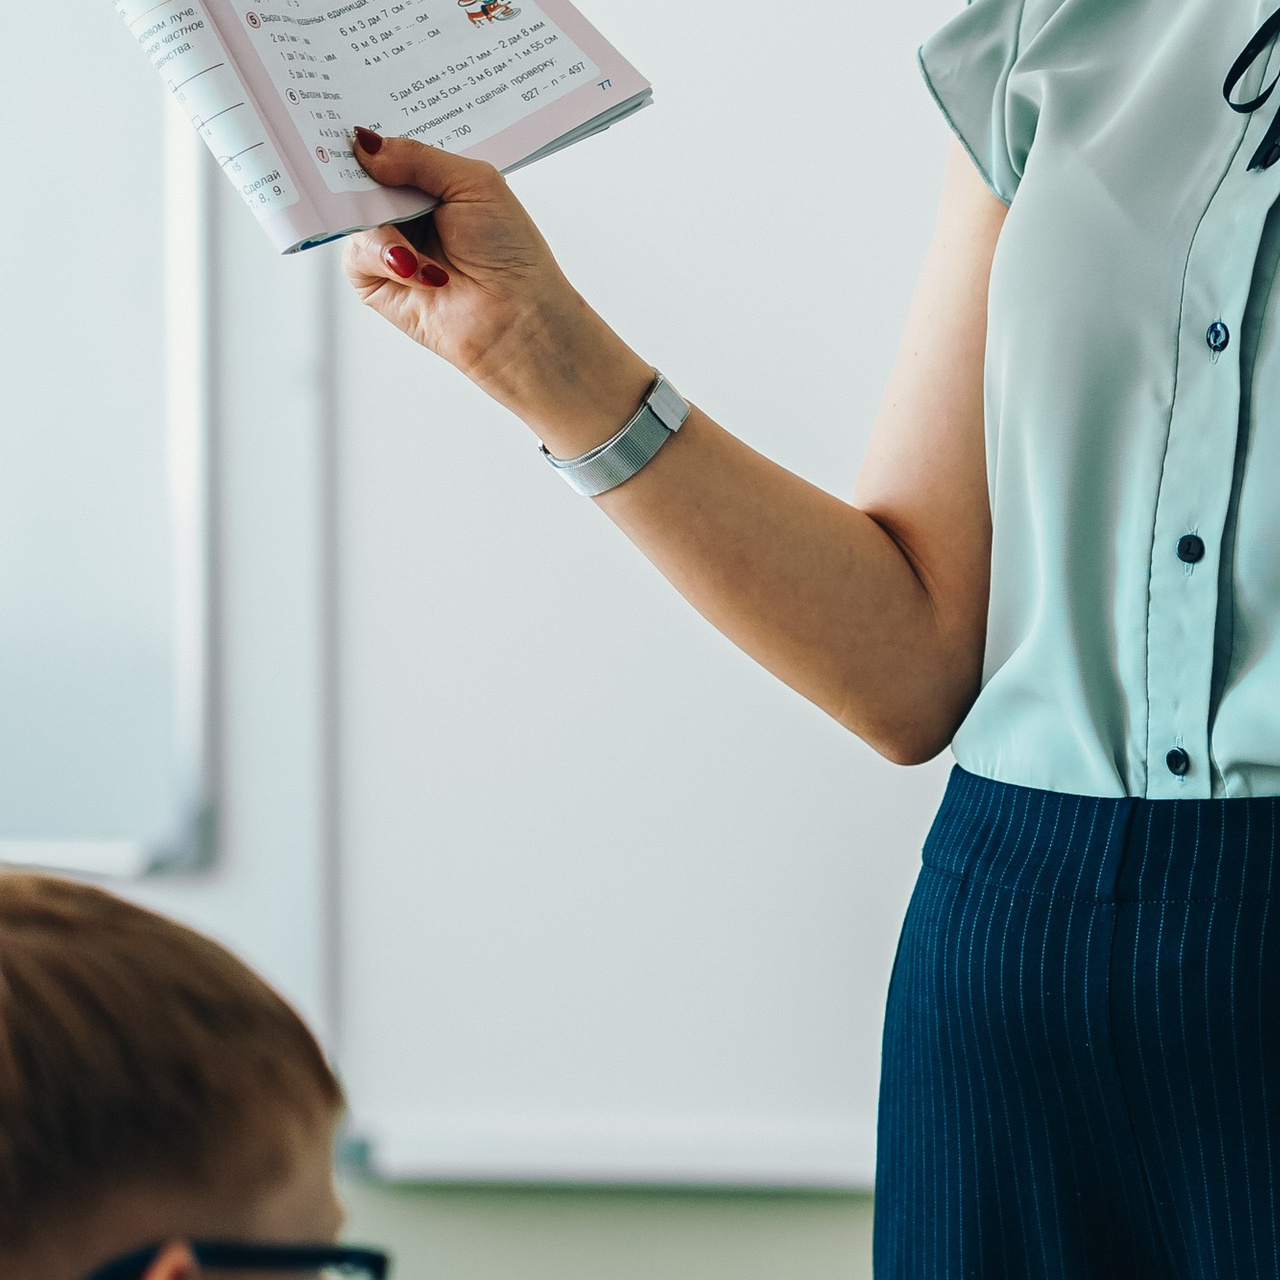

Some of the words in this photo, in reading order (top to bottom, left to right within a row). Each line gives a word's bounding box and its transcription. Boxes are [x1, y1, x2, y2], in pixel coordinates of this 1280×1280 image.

[170, 8, 198, 23] луче.
[339, 27, 348, 37] 6
[357, 20, 366, 29] 3
[367, 15, 382, 27] дм
[380, 9, 389, 18] 7
[391, 4, 405, 14] см
[162, 20, 204, 45] частное
[350, 43, 360, 52] 9
[369, 35, 378, 45] 8
[379, 30, 394, 42] дм
[415, 13, 430, 23] см
[391, 45, 406, 56] см
[427, 28, 441, 38] см
[324, 53, 338, 62] мм
[390, 92, 399, 102] 5
[399, 88, 413, 99] дм
[411, 80, 425, 92] 83
[425, 75, 441, 85] мм
[447, 65, 456, 75] 9
[455, 61, 470, 71] см
[467, 56, 476, 65] 7
[476, 50, 493, 61] мм
[498, 40, 508, 50] 2
[508, 34, 522, 46] дм
[521, 28, 530, 37] 8
[529, 21, 546, 33] мм
[401, 108, 410, 117] 7
[410, 105, 420, 114] м
[418, 100, 427, 109] 3
[427, 95, 442, 107] дм
[439, 90, 449, 99] 5
[448, 84, 463, 95] см
[468, 76, 477, 85] 3
[476, 73, 486, 82] м
[484, 68, 493, 77] 6
[493, 63, 508, 75] дм
[530, 41, 545, 51] 55
[544, 34, 559, 45] см
[475, 83, 509, 105] сделай
[510, 56, 558, 86] проверку:
[521, 87, 540, 102] 827
[568, 61, 586, 76] 497
[597, 79, 613, 91] 77
[368, 122, 382, 132] см
[451, 124, 472, 138] 700
[243, 169, 281, 196] Сделай
[258, 193, 271, 204] 8,
[272, 185, 286, 196] 9.
